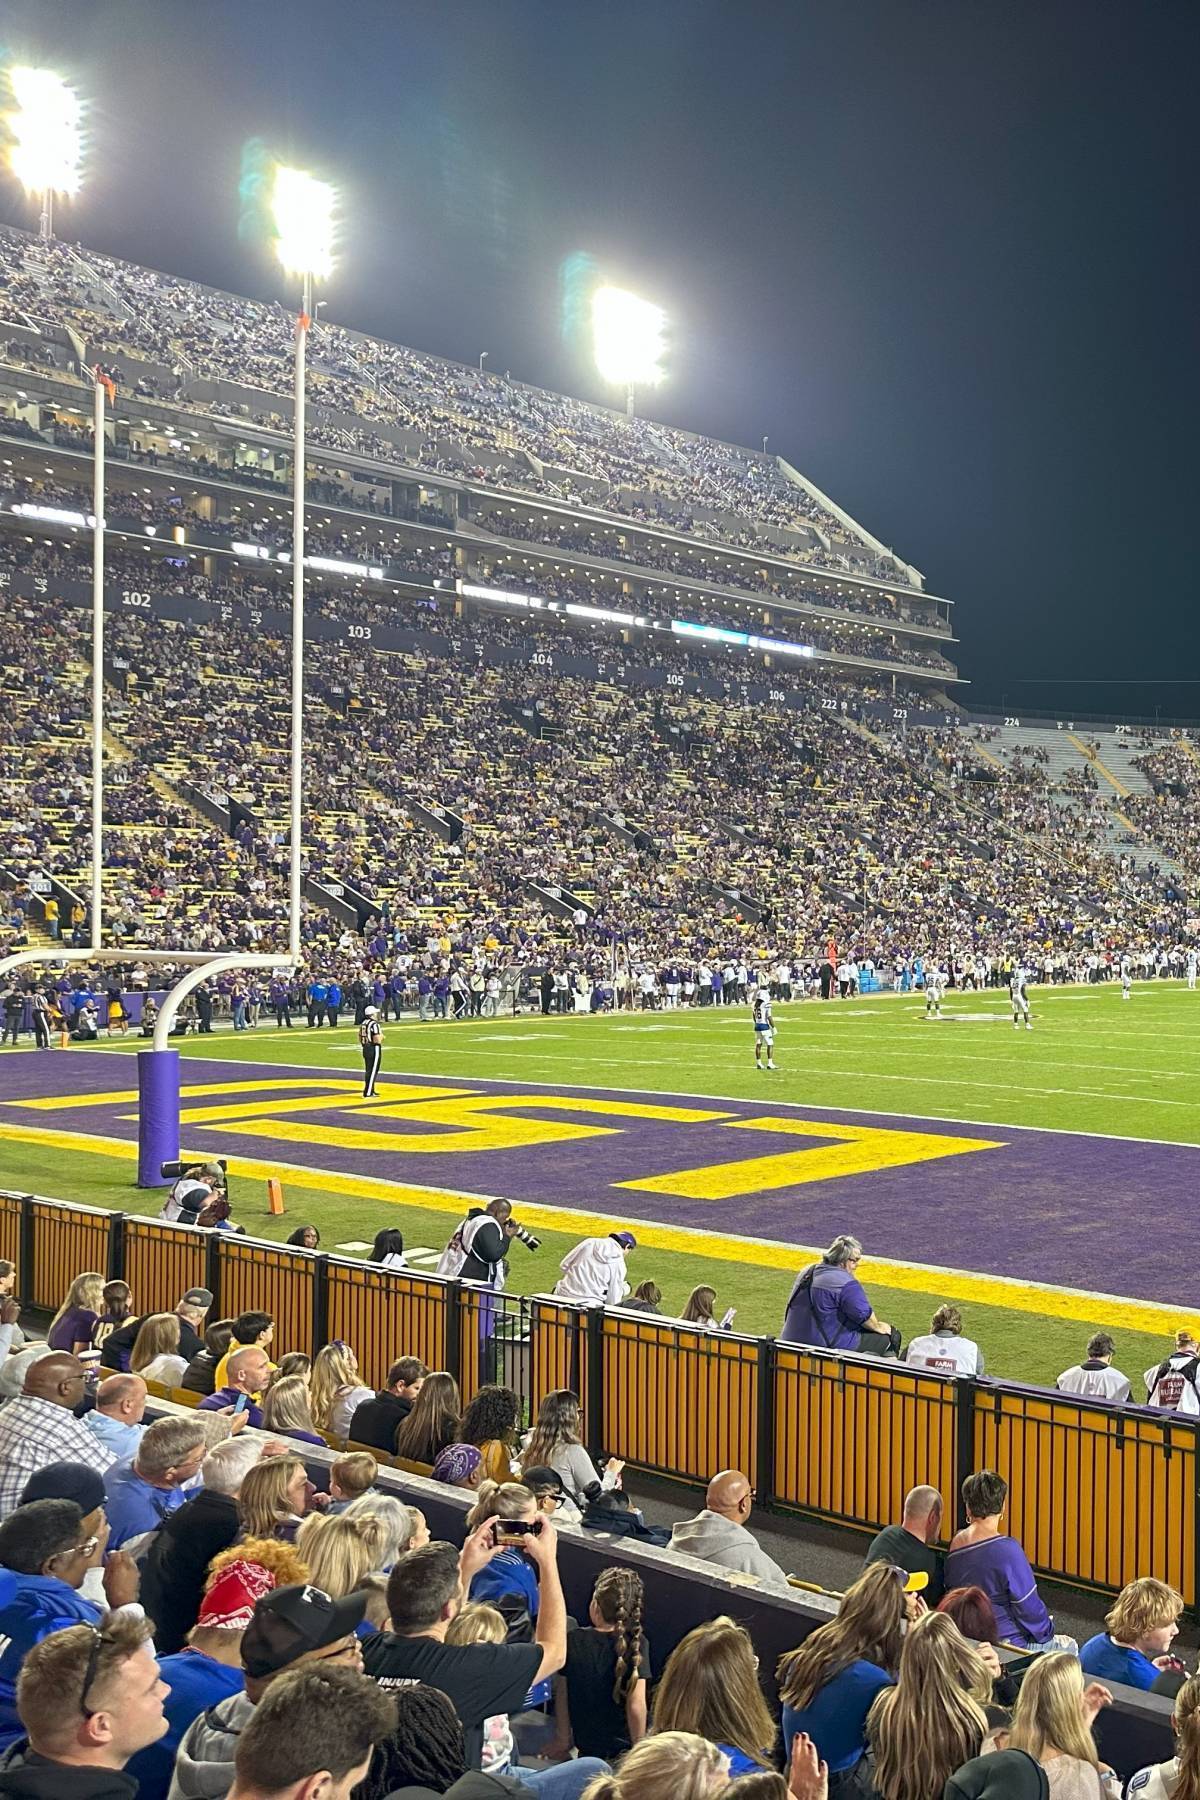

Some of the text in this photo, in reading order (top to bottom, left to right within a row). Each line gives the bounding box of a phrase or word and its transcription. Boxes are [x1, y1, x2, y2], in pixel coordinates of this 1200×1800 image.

[122, 591, 151, 608] 102
[348, 625, 371, 639] 103
[531, 653, 553, 666] 104
[666, 674, 684, 686] 105
[769, 690, 785, 701] 106
[821, 699, 837, 710] 222
[893, 708, 908, 719] 223
[1004, 717, 1020, 727] 224
